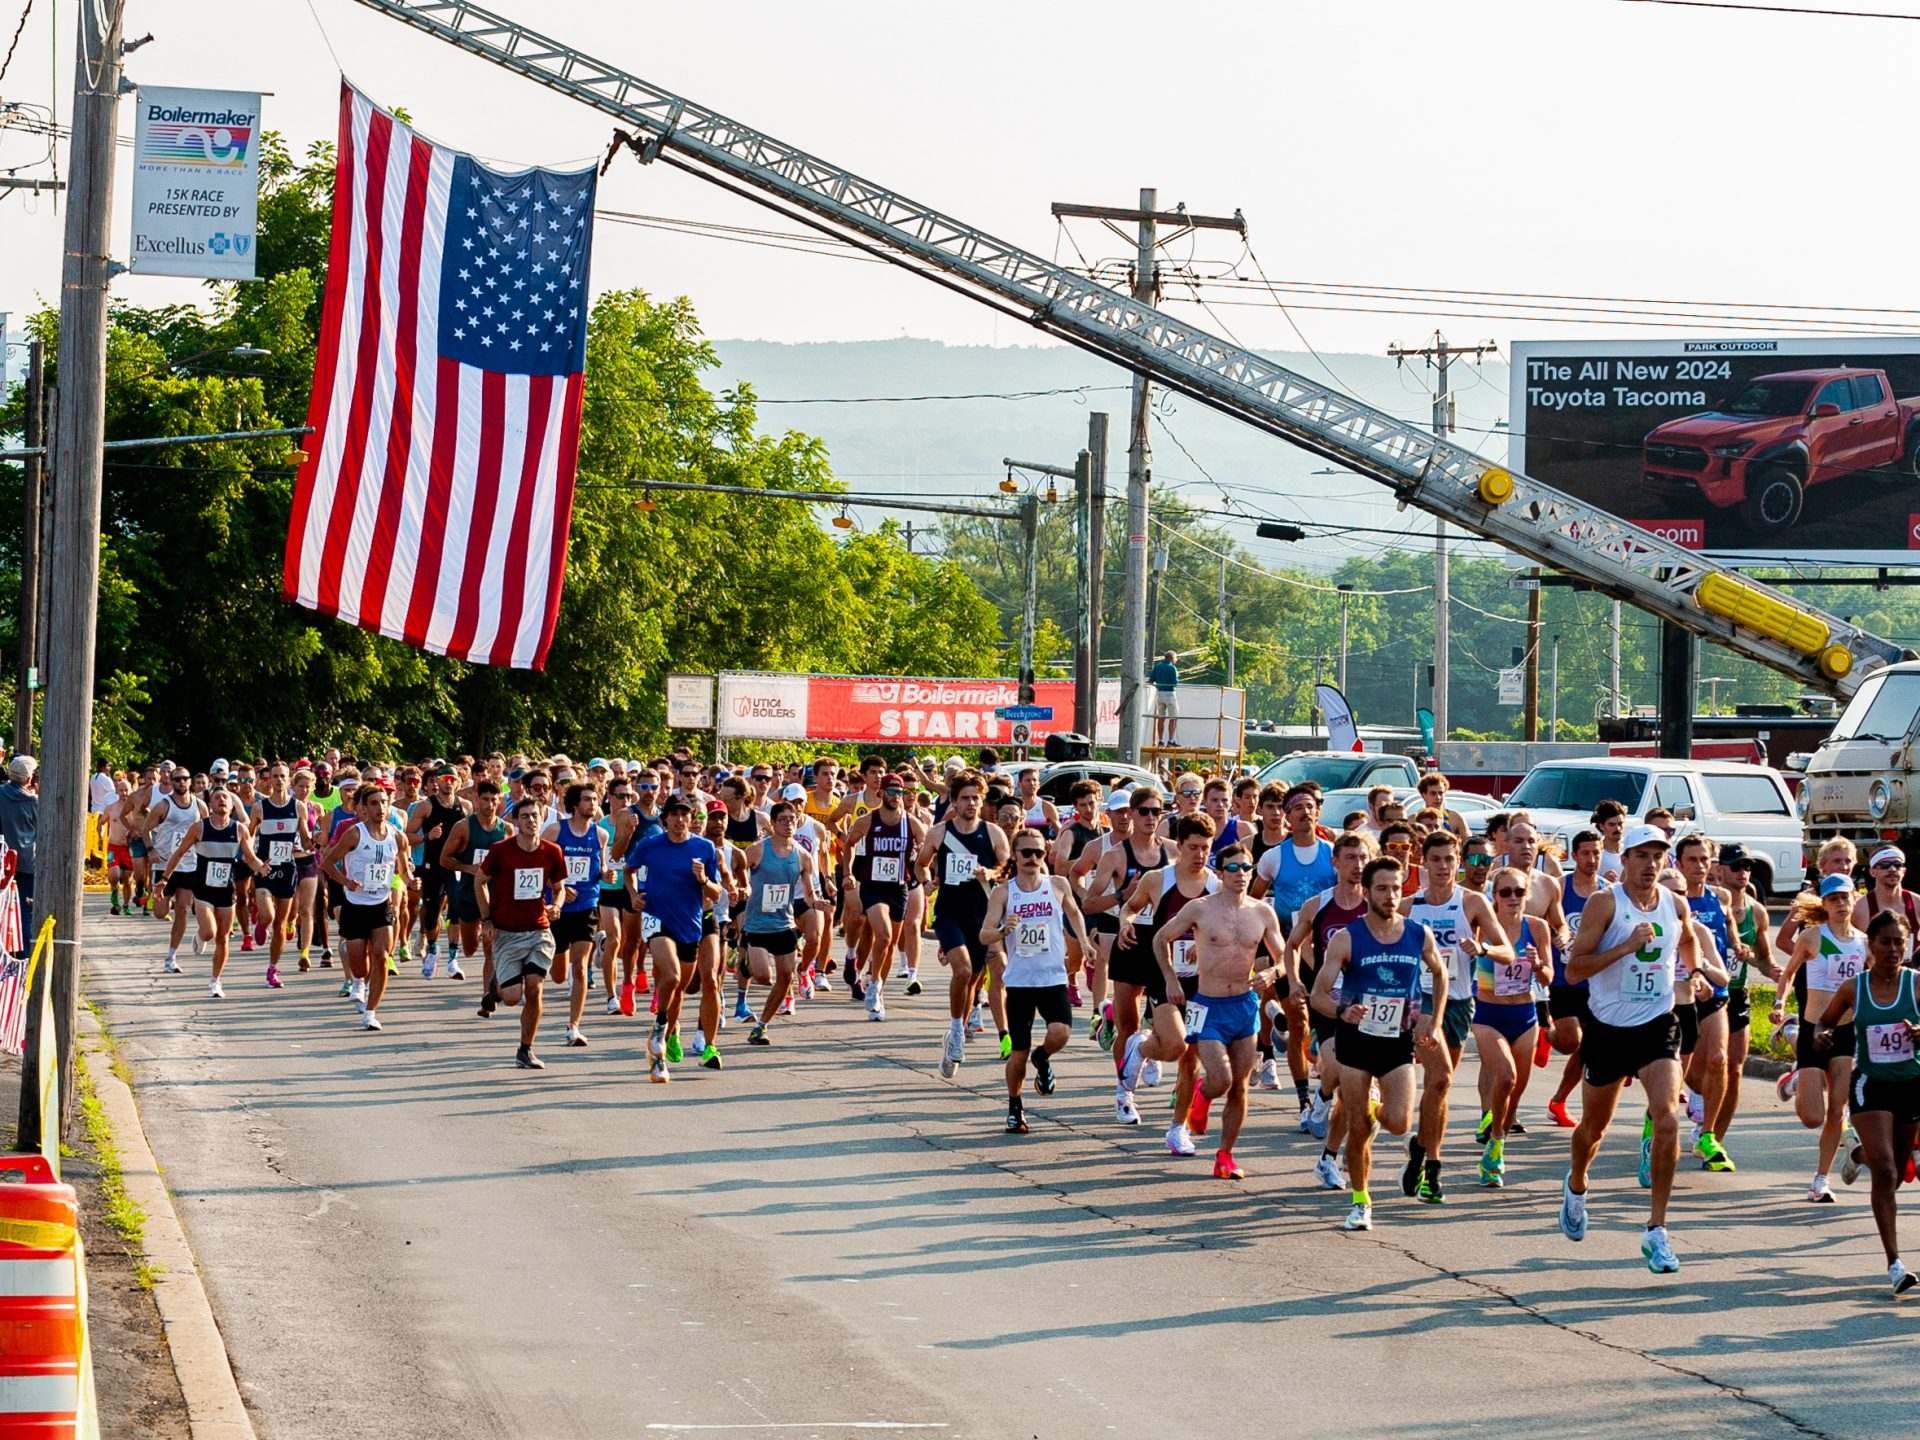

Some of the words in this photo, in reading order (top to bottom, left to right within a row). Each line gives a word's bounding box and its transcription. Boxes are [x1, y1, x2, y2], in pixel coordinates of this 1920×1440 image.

[148, 104, 255, 126] Boilermaker
[166, 188, 189, 200] 15K
[190, 190, 225, 202] RACE
[148, 202, 221, 217] PRESENTED
[222, 206, 240, 218] BY
[135, 234, 205, 255] Excellus
[1688, 343, 1717, 351] PARK
[1719, 342, 1775, 350] OUTDOOR
[1527, 361, 1572, 380] The
[1578, 361, 1608, 380] All
[1616, 361, 1670, 380] New
[1675, 360, 1732, 380] 2024
[1527, 387, 1606, 411] Toyota
[1613, 387, 1706, 406] Tacoma
[902, 684, 1020, 705] Boilermake
[753, 698, 781, 708] UTICA
[753, 708, 796, 718] BOILERS
[879, 710, 1000, 739] START
[273, 845, 288, 857] 271
[211, 867, 228, 879] 105
[569, 861, 586, 875] 167
[877, 863, 896, 875] 148
[951, 859, 972, 873] 164
[370, 869, 387, 881] 143
[519, 874, 539, 889] 221
[769, 890, 786, 902] 177
[1013, 902, 1053, 915] LEONIA
[1035, 910, 1053, 918] CLUB
[1020, 928, 1046, 945] 204
[1433, 930, 1457, 947] RC
[1504, 964, 1523, 981] 42
[1837, 961, 1855, 978] 46
[1635, 972, 1655, 992] 15
[1186, 1008, 1200, 1026] 61
[1370, 1003, 1397, 1022] 137
[1880, 1032, 1902, 1051] 49
